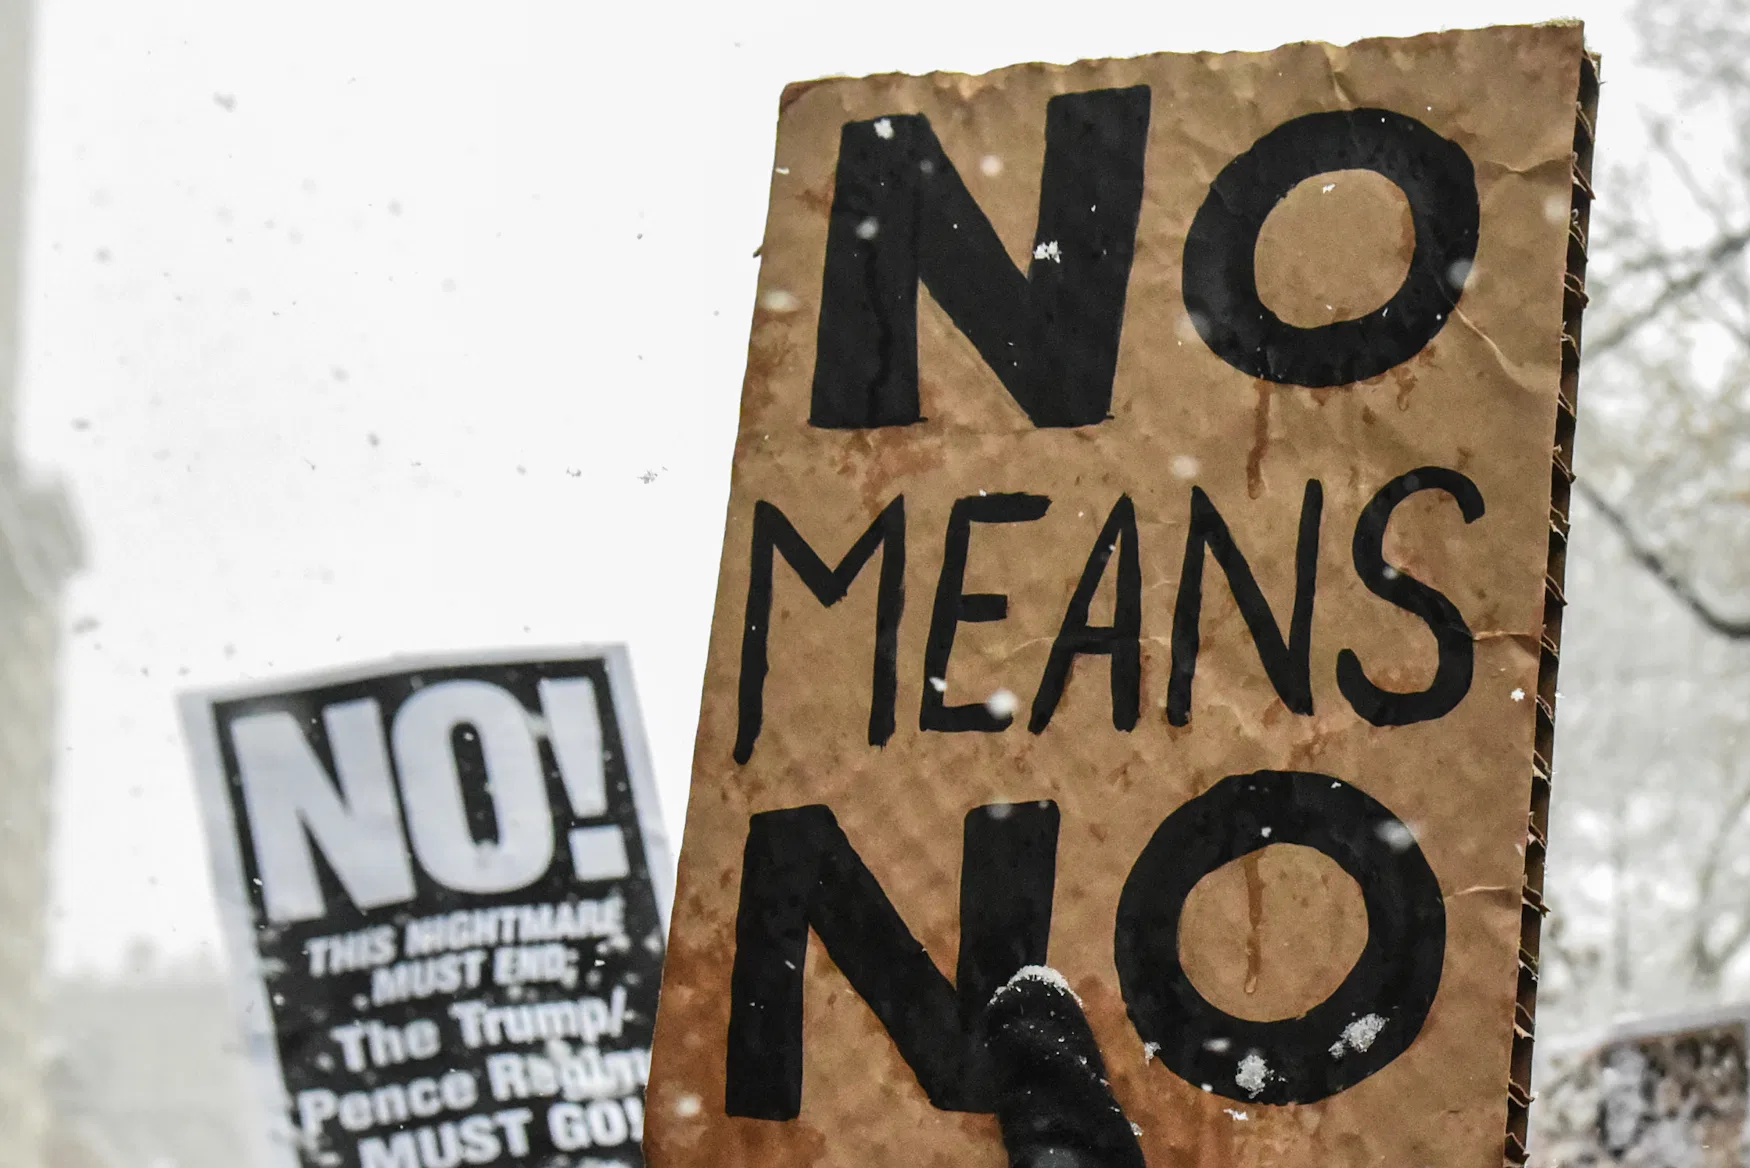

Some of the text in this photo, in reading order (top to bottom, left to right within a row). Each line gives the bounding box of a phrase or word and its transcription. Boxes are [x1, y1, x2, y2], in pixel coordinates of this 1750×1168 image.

[807, 85, 1480, 429] NO
[733, 465, 1485, 766] MEANS
[229, 676, 629, 923] NO!
[305, 924, 397, 978] THIS
[371, 950, 487, 1006] MUST
[725, 769, 1446, 1120] NO
[330, 985, 627, 1073] The Trump/
[297, 1045, 653, 1143] Pence Regim
[547, 1096, 647, 1151] GO!
